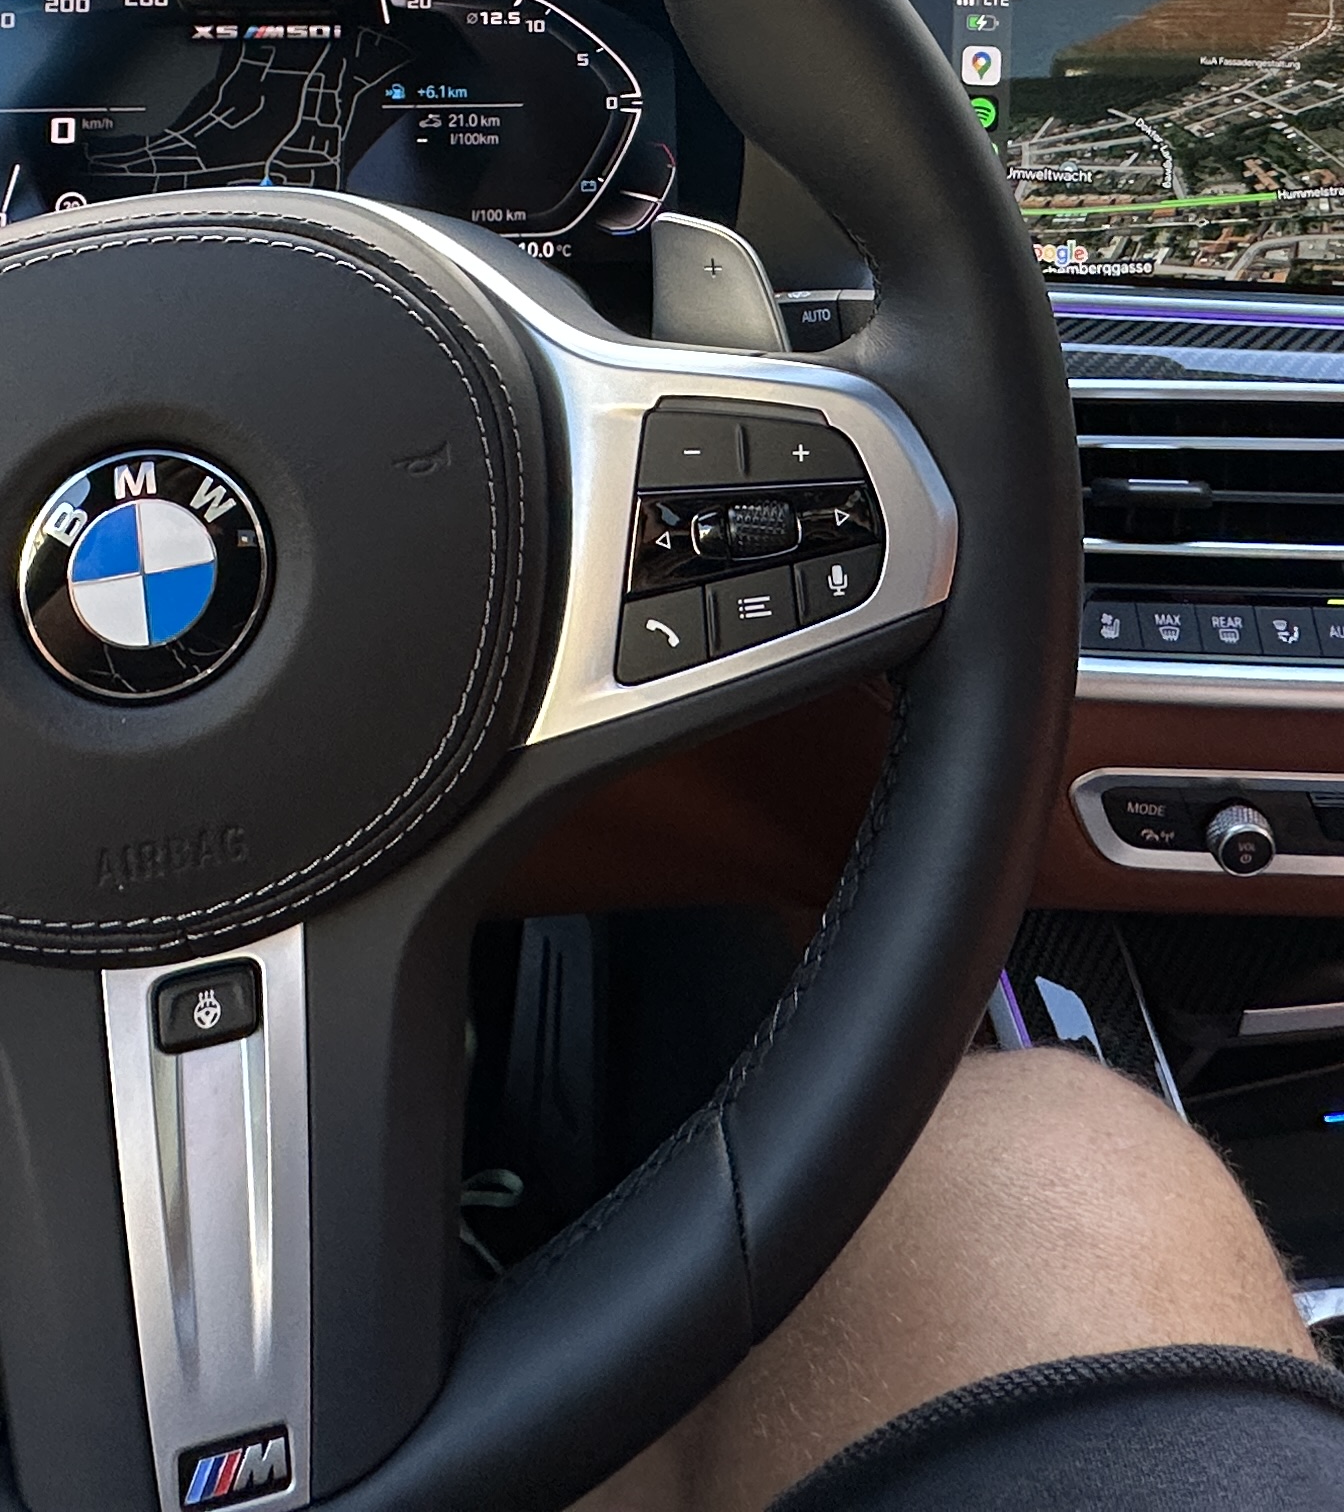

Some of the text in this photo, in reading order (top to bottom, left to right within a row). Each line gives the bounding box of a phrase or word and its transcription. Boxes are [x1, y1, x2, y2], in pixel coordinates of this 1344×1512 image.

[191, 25, 239, 39] X5
[526, 19, 546, 33] 10
[577, 53, 589, 67] 5
[606, 96, 618, 110] 0
[448, 114, 501, 127] 21.0 km
[51, 117, 113, 144] 0 km/h
[506, 209, 527, 221] km
[1033, 240, 1086, 266] oogle
[802, 308, 831, 324] AUTO
[45, 460, 238, 548] BMW
[1154, 614, 1181, 627] MAX
[1212, 616, 1243, 629] REAR
[1127, 801, 1166, 817] MODE
[96, 826, 250, 889] AIRBAG
